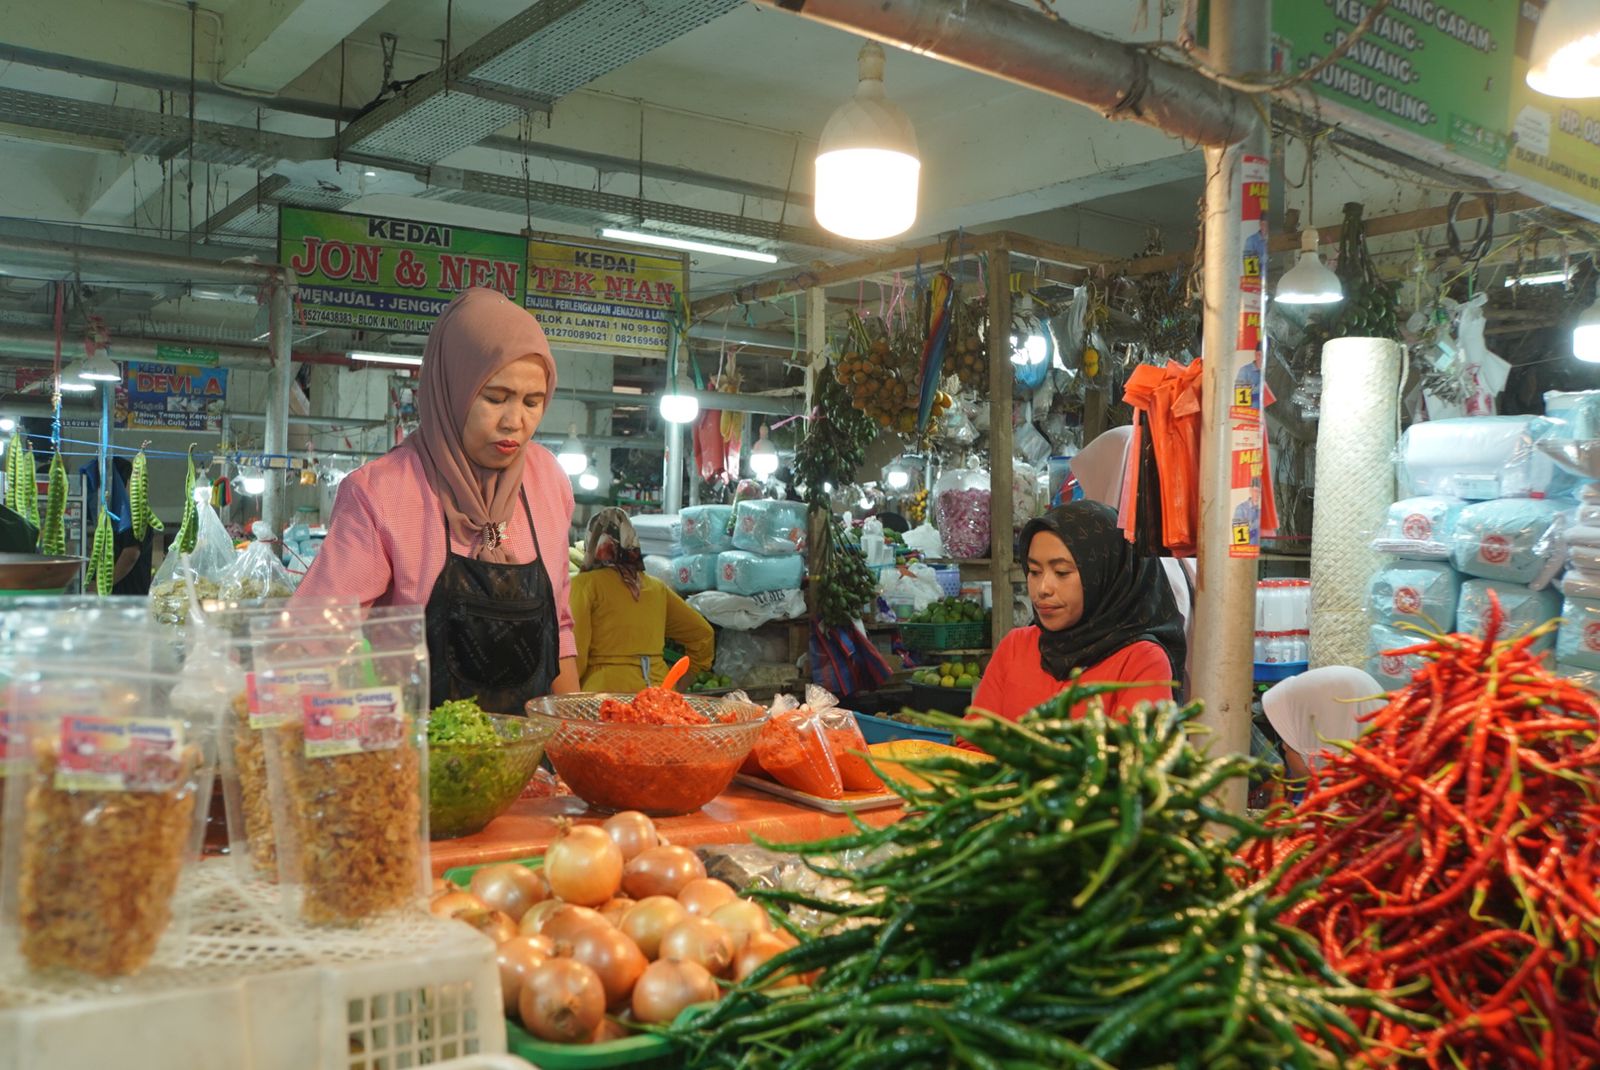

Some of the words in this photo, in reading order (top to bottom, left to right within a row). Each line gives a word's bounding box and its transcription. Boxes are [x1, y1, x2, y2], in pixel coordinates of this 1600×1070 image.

[1435, 8, 1490, 52] GARAM
[1375, 84, 1429, 125] GILING
[368, 218, 452, 248] KEDAI
[291, 236, 382, 283] JON
[394, 249, 427, 288] &
[439, 254, 520, 298] NEN
[575, 250, 636, 274] KEDAI
[1248, 260, 1257, 274] 1
[531, 266, 596, 296] TEK
[605, 275, 675, 304] NIAN
[300, 288, 375, 307] MENJUAL
[556, 299, 611, 315] PERLENGKAPAN
[613, 306, 644, 319] JENAZAH
[645, 309, 651, 319] &
[358, 314, 379, 328] BLOK
[380, 316, 386, 328] A
[536, 314, 562, 325] BLOK
[565, 316, 572, 325] A
[576, 318, 609, 329] LANTAI
[621, 322, 634, 331] NO
[637, 324, 667, 335] 99-100
[1239, 390, 1249, 404] 1
[1237, 527, 1247, 542] 1
